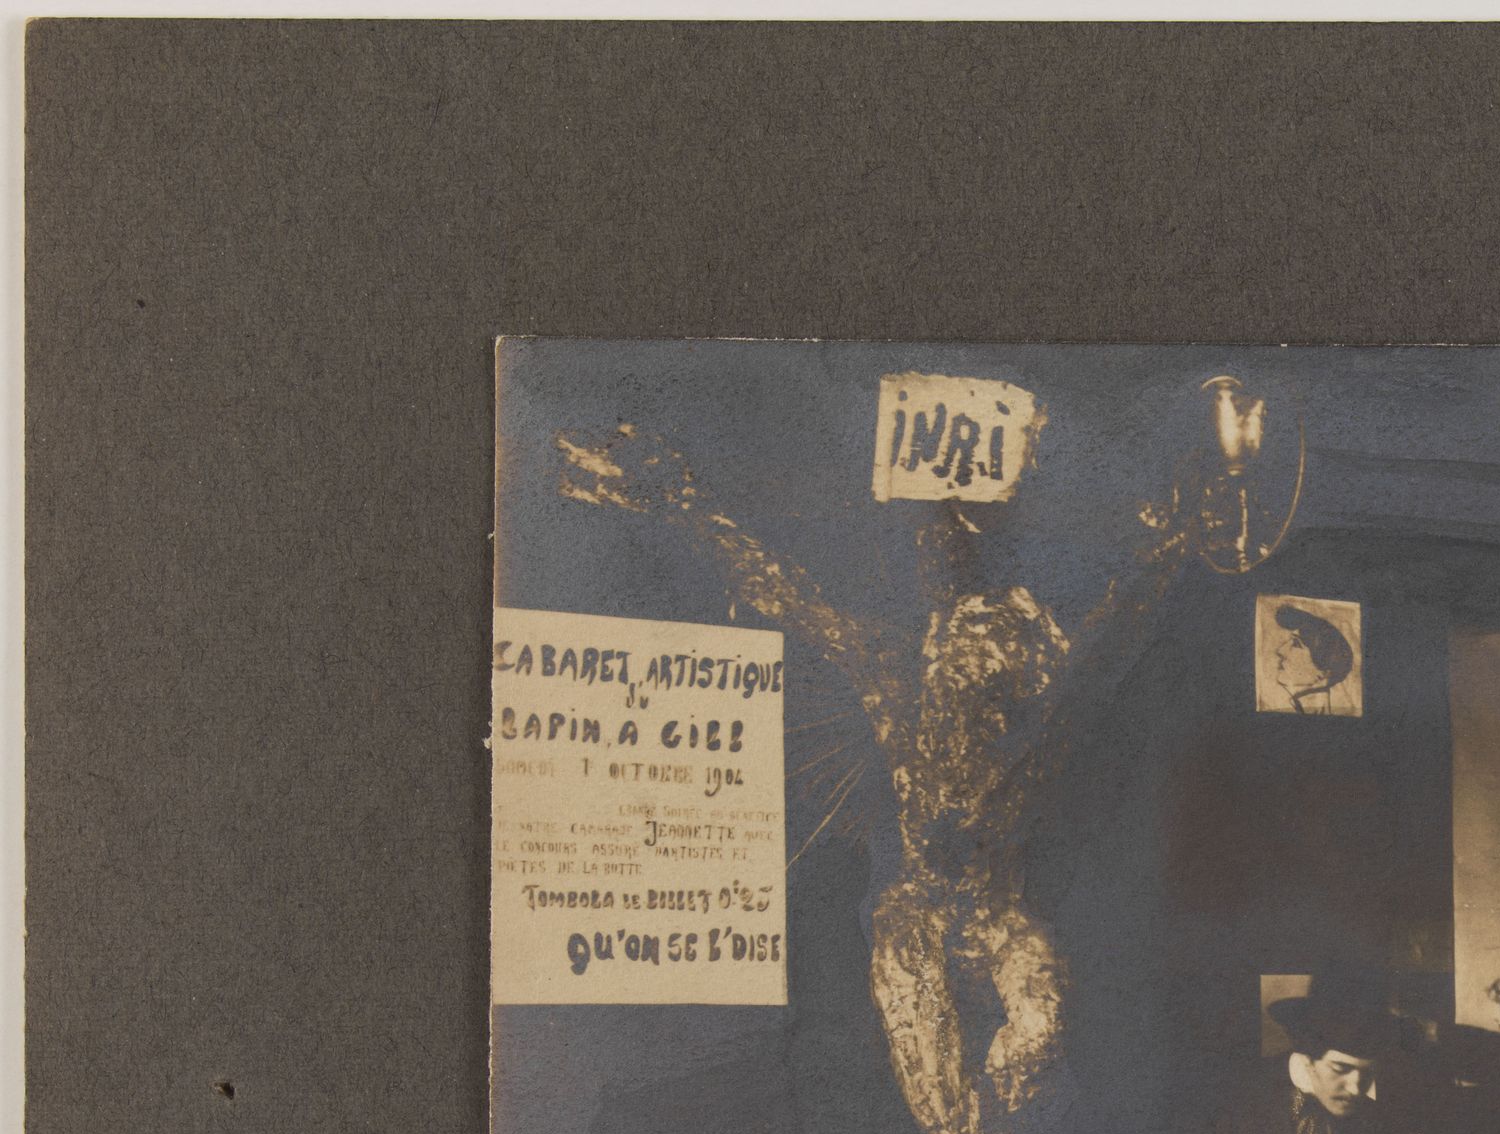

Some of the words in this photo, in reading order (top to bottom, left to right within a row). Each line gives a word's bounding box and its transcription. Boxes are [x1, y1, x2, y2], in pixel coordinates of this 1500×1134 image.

[494, 641, 632, 687] CABARET
[646, 650, 784, 699] ARTISTIQUE
[704, 766, 744, 797] 1904
[668, 932, 698, 962] SE
